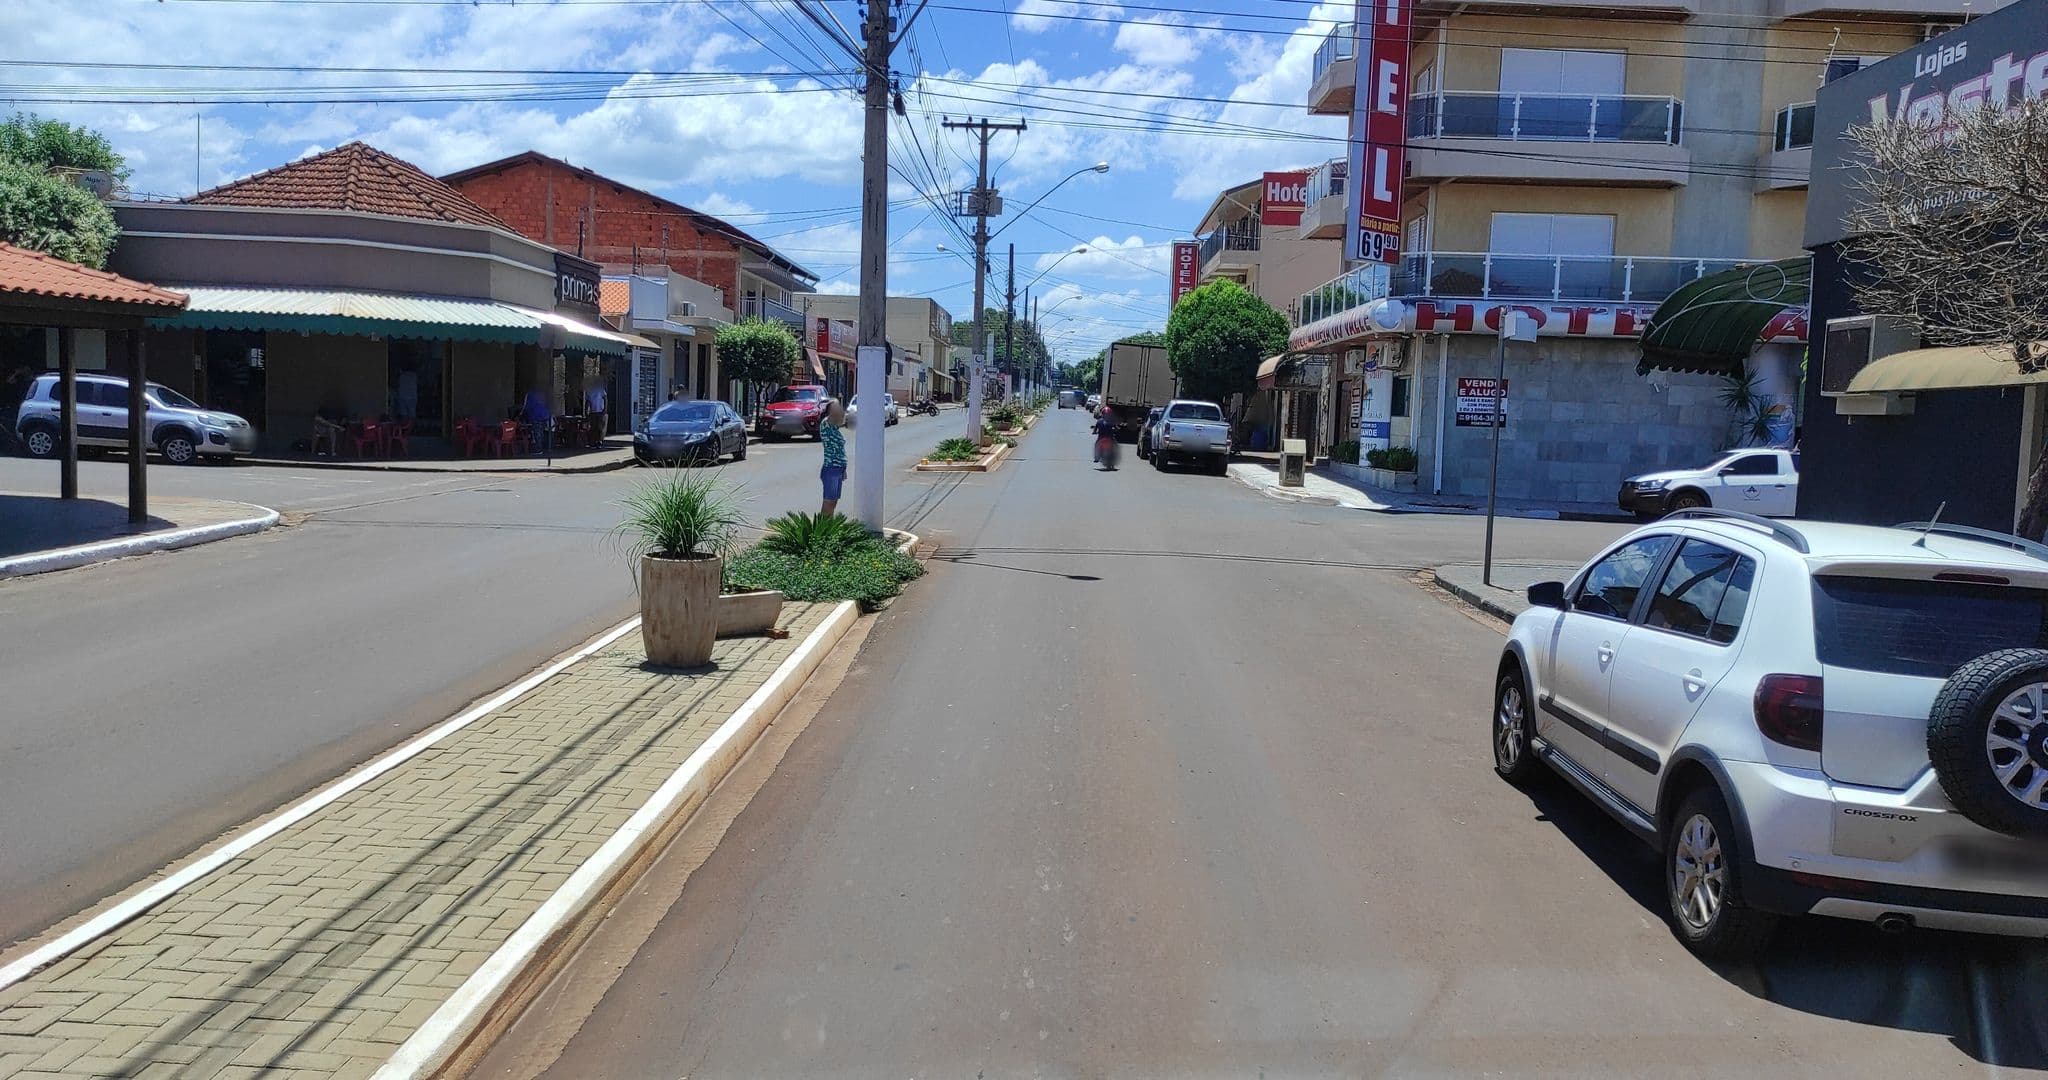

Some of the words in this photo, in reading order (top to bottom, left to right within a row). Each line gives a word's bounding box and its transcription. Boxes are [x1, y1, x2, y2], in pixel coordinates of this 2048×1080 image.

[1914, 40, 1968, 78] Lojas
[1266, 181, 1307, 203] Hote
[1179, 247, 1193, 285] HOTEL
[561, 273, 599, 305] primas
[1459, 388, 1467, 396] E
[1465, 379, 1497, 388] VEND
[1843, 807, 1919, 822] CROSSFOX
